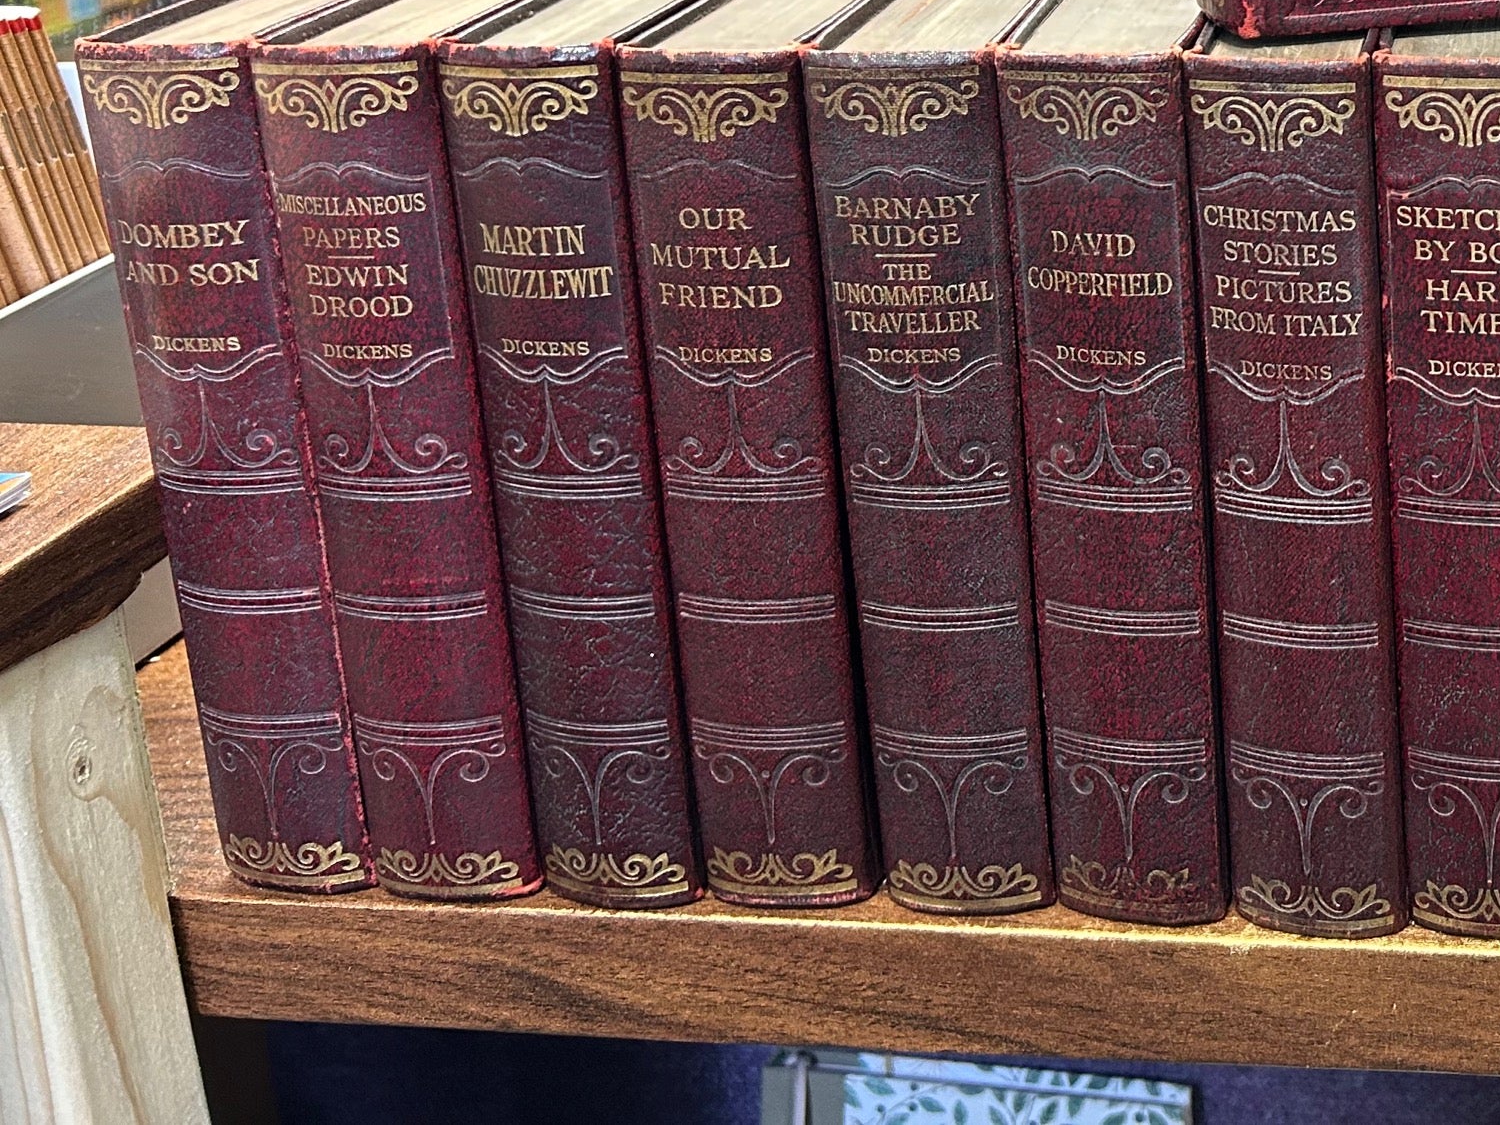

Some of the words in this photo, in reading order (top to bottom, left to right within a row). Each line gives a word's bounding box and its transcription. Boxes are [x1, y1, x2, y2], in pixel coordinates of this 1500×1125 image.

[278, 192, 427, 216] MISCELLANEOUS
[835, 192, 980, 221] BARNABY
[679, 207, 753, 231] OUR
[1203, 204, 1356, 233] CHRISTMAS
[117, 219, 250, 249] DOMBEY
[302, 226, 401, 250] PAPERS
[480, 222, 586, 256] MARTIN
[849, 223, 961, 248] RUDGE
[1051, 230, 1136, 258] DAVID
[651, 242, 790, 270] MUTUAL
[1223, 240, 1338, 266] STORIES
[1414, 239, 1455, 261] BY
[126, 262, 178, 286] AND
[189, 258, 261, 286] SON
[305, 263, 409, 287] EDWIN
[474, 264, 613, 299] CHUZZLEWIT
[882, 263, 931, 281] THE
[1027, 266, 1173, 298] COPPERFIELD
[659, 282, 783, 309] FRIEND
[833, 280, 994, 307] UNCOMMERCIAL
[1216, 274, 1353, 304] PICTURES
[310, 294, 413, 318] DROOD
[845, 309, 981, 334] TRAVELLER
[1210, 306, 1276, 335] FROM
[1283, 311, 1363, 338] ITALY
[152, 335, 241, 353] DICKENS
[322, 342, 413, 359] DICKENS
[501, 337, 590, 356] DICKENS
[679, 346, 772, 363] DICKENS
[867, 347, 961, 364] DICKENS
[1056, 345, 1146, 365] DICKENS
[1241, 359, 1332, 381] DICKENS
